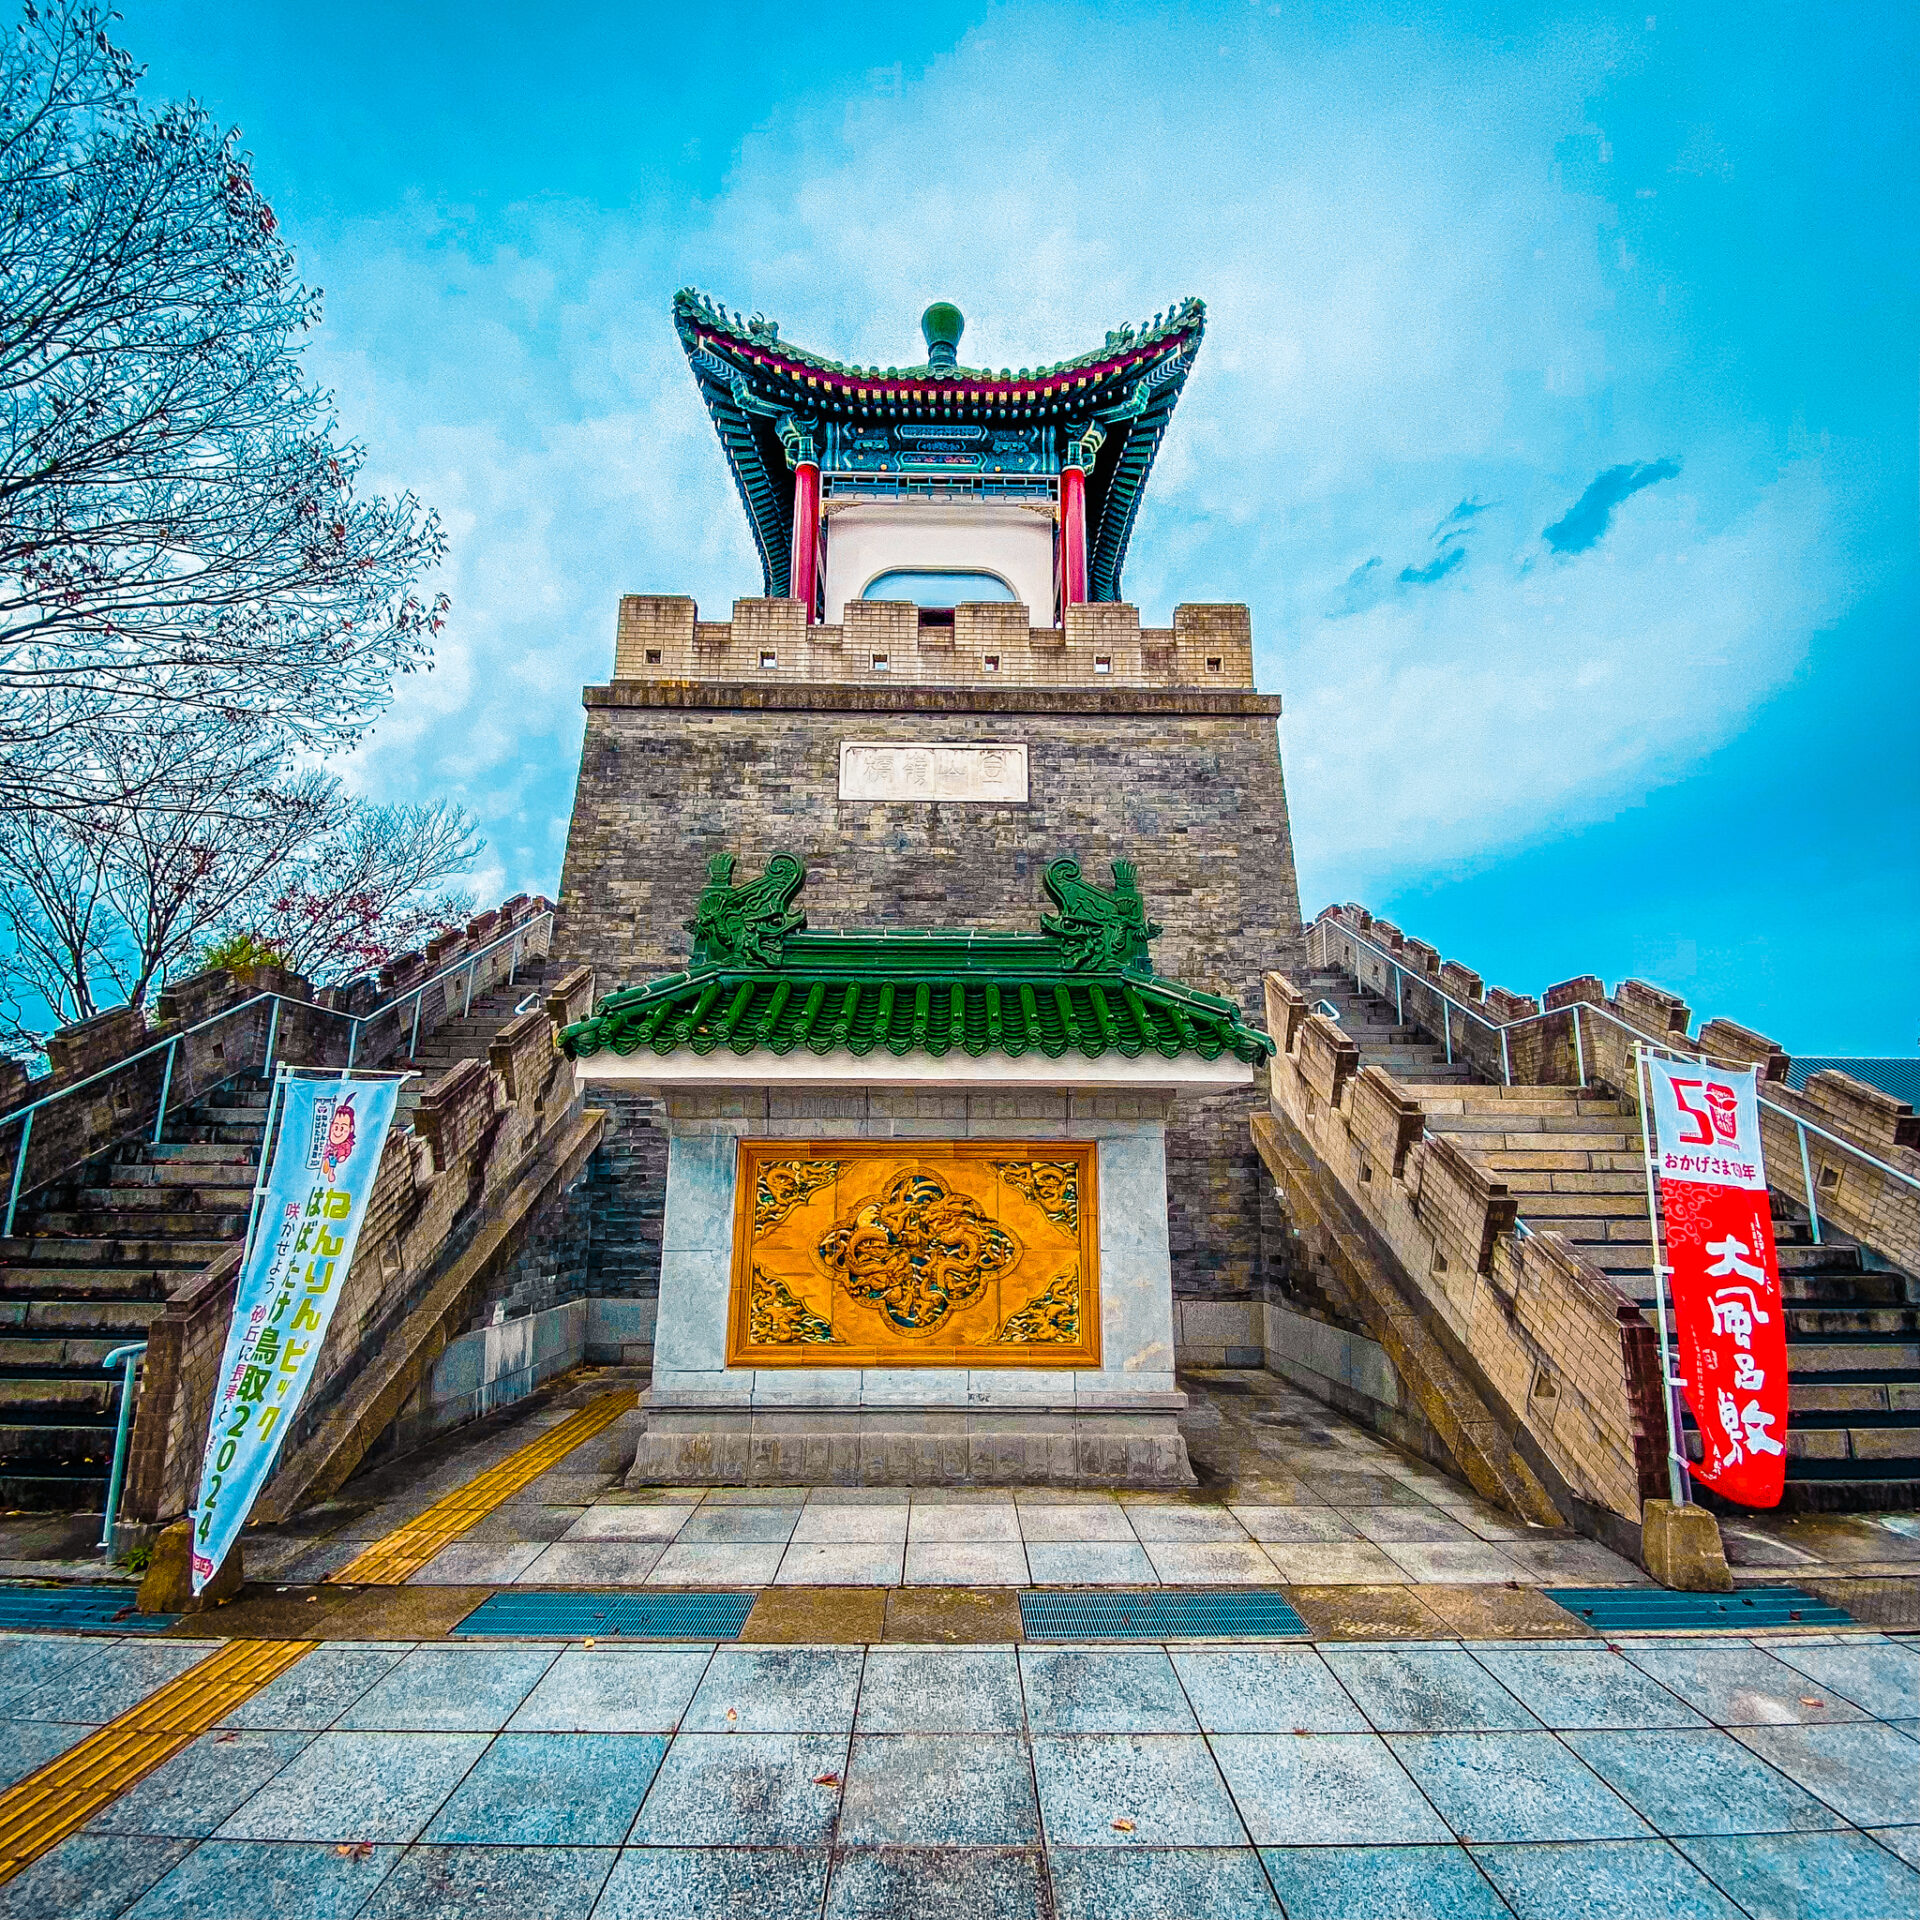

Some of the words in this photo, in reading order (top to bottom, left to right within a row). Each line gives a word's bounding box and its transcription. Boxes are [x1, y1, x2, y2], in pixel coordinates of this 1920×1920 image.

[256, 1187, 351, 1442] ねんりんピック
[1703, 1233, 1785, 1468] 大風呂敷
